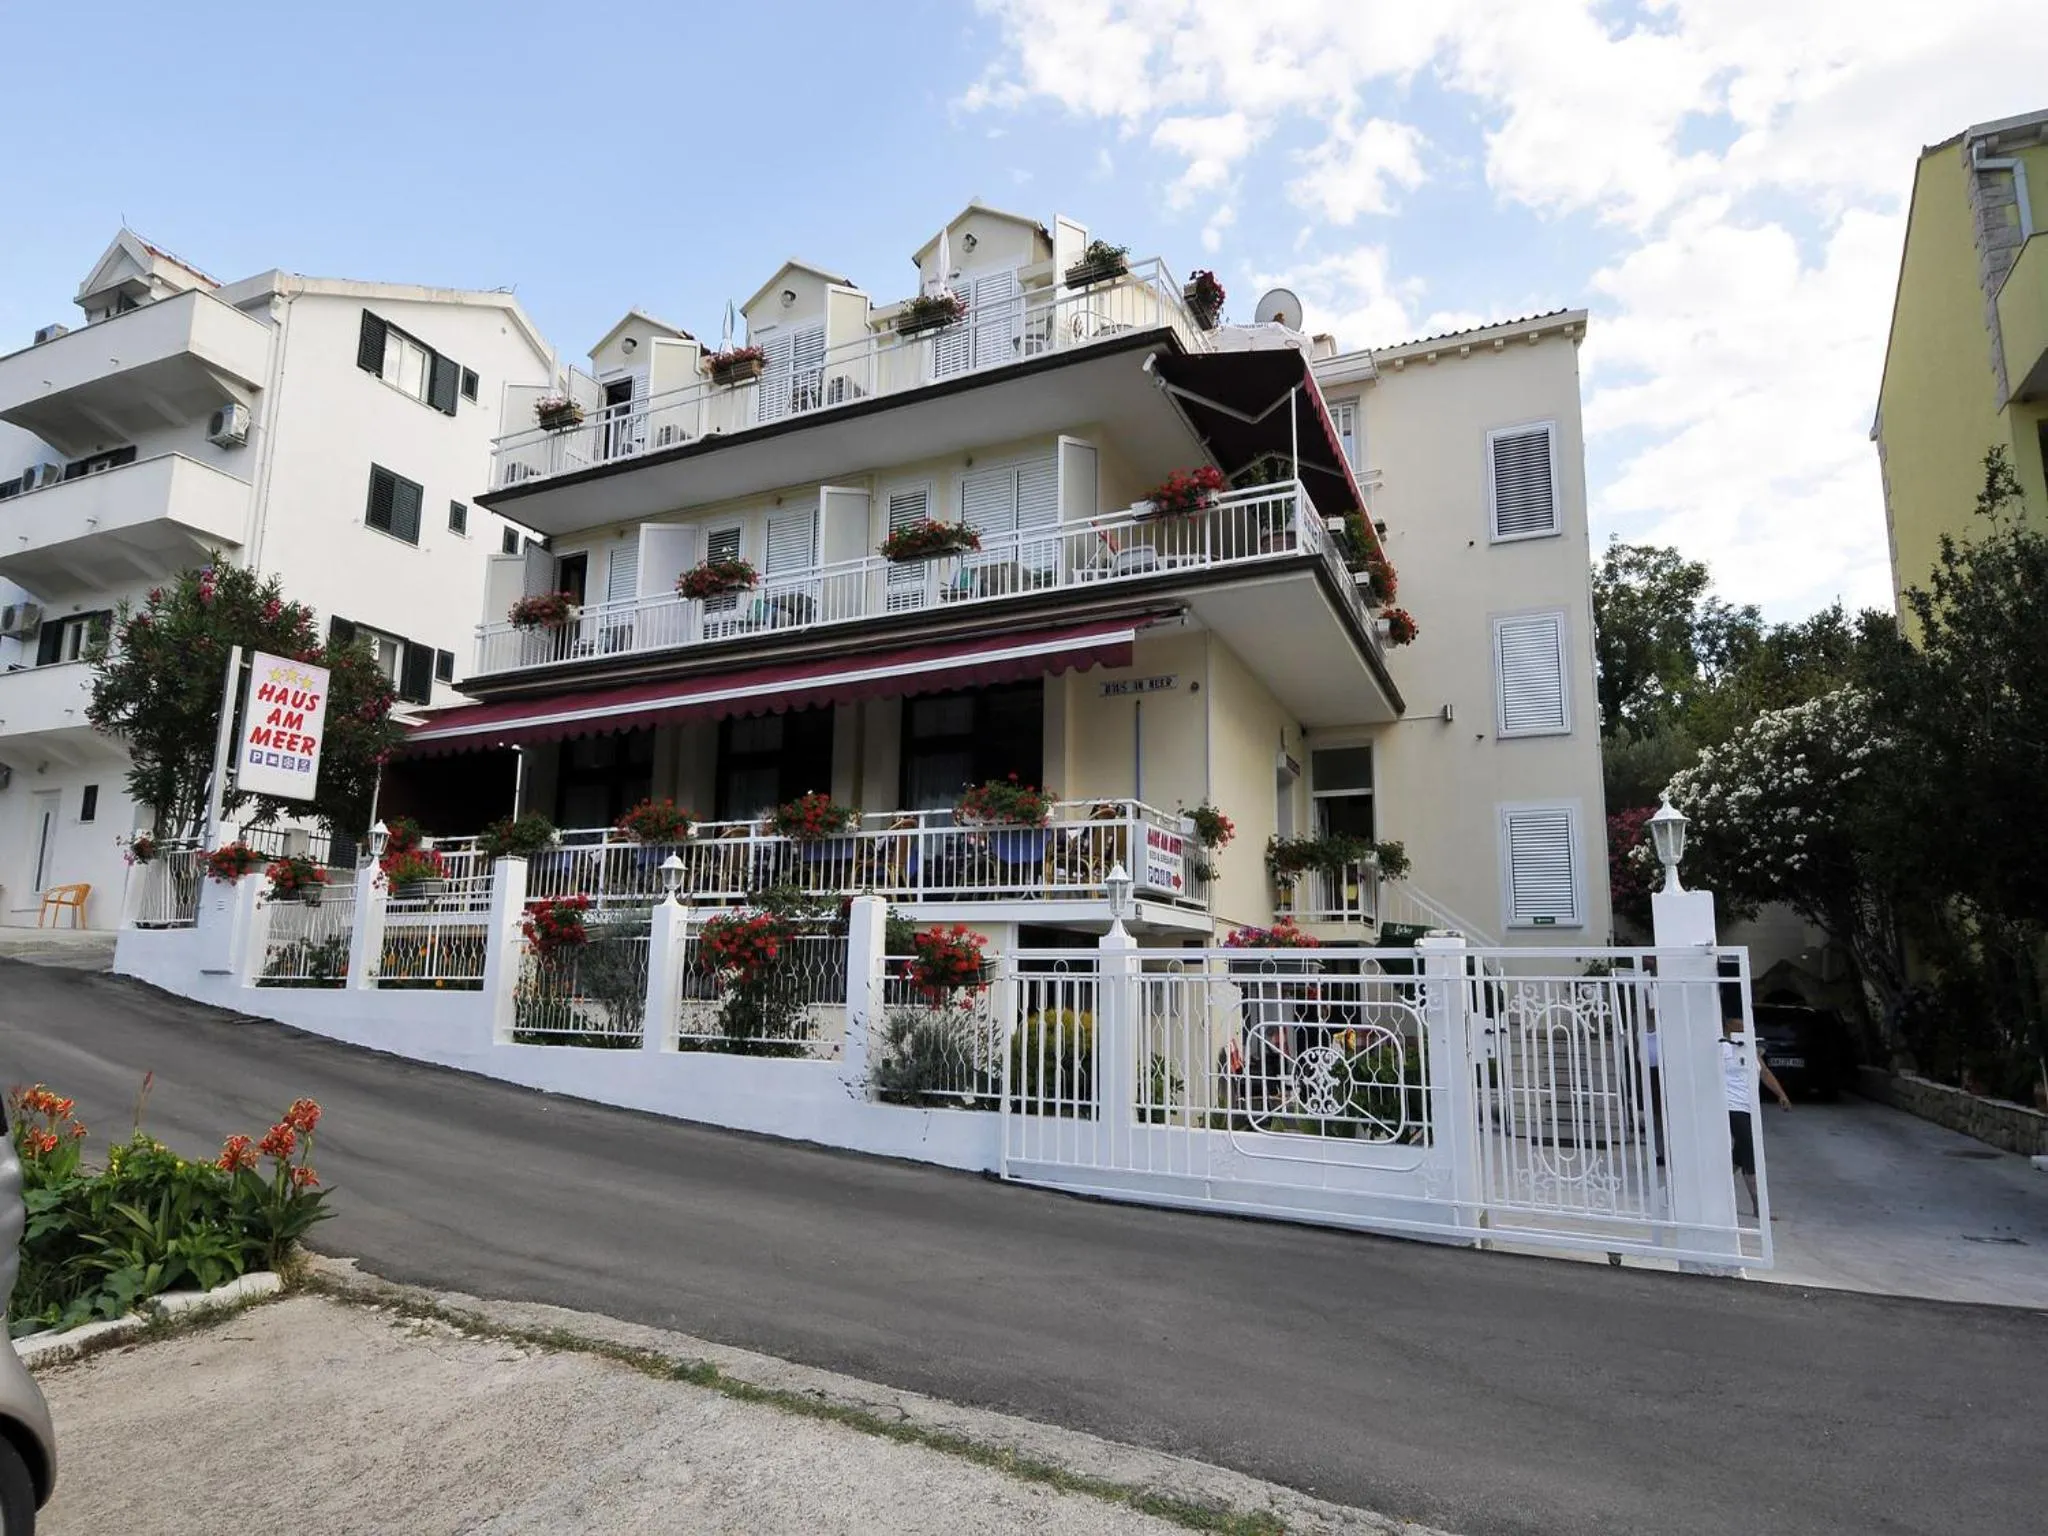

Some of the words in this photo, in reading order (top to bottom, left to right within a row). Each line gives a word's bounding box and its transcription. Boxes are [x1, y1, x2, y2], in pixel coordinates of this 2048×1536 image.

[257, 683, 320, 711] HAUS
[266, 708, 304, 730] AM
[249, 726, 316, 756] MEER
